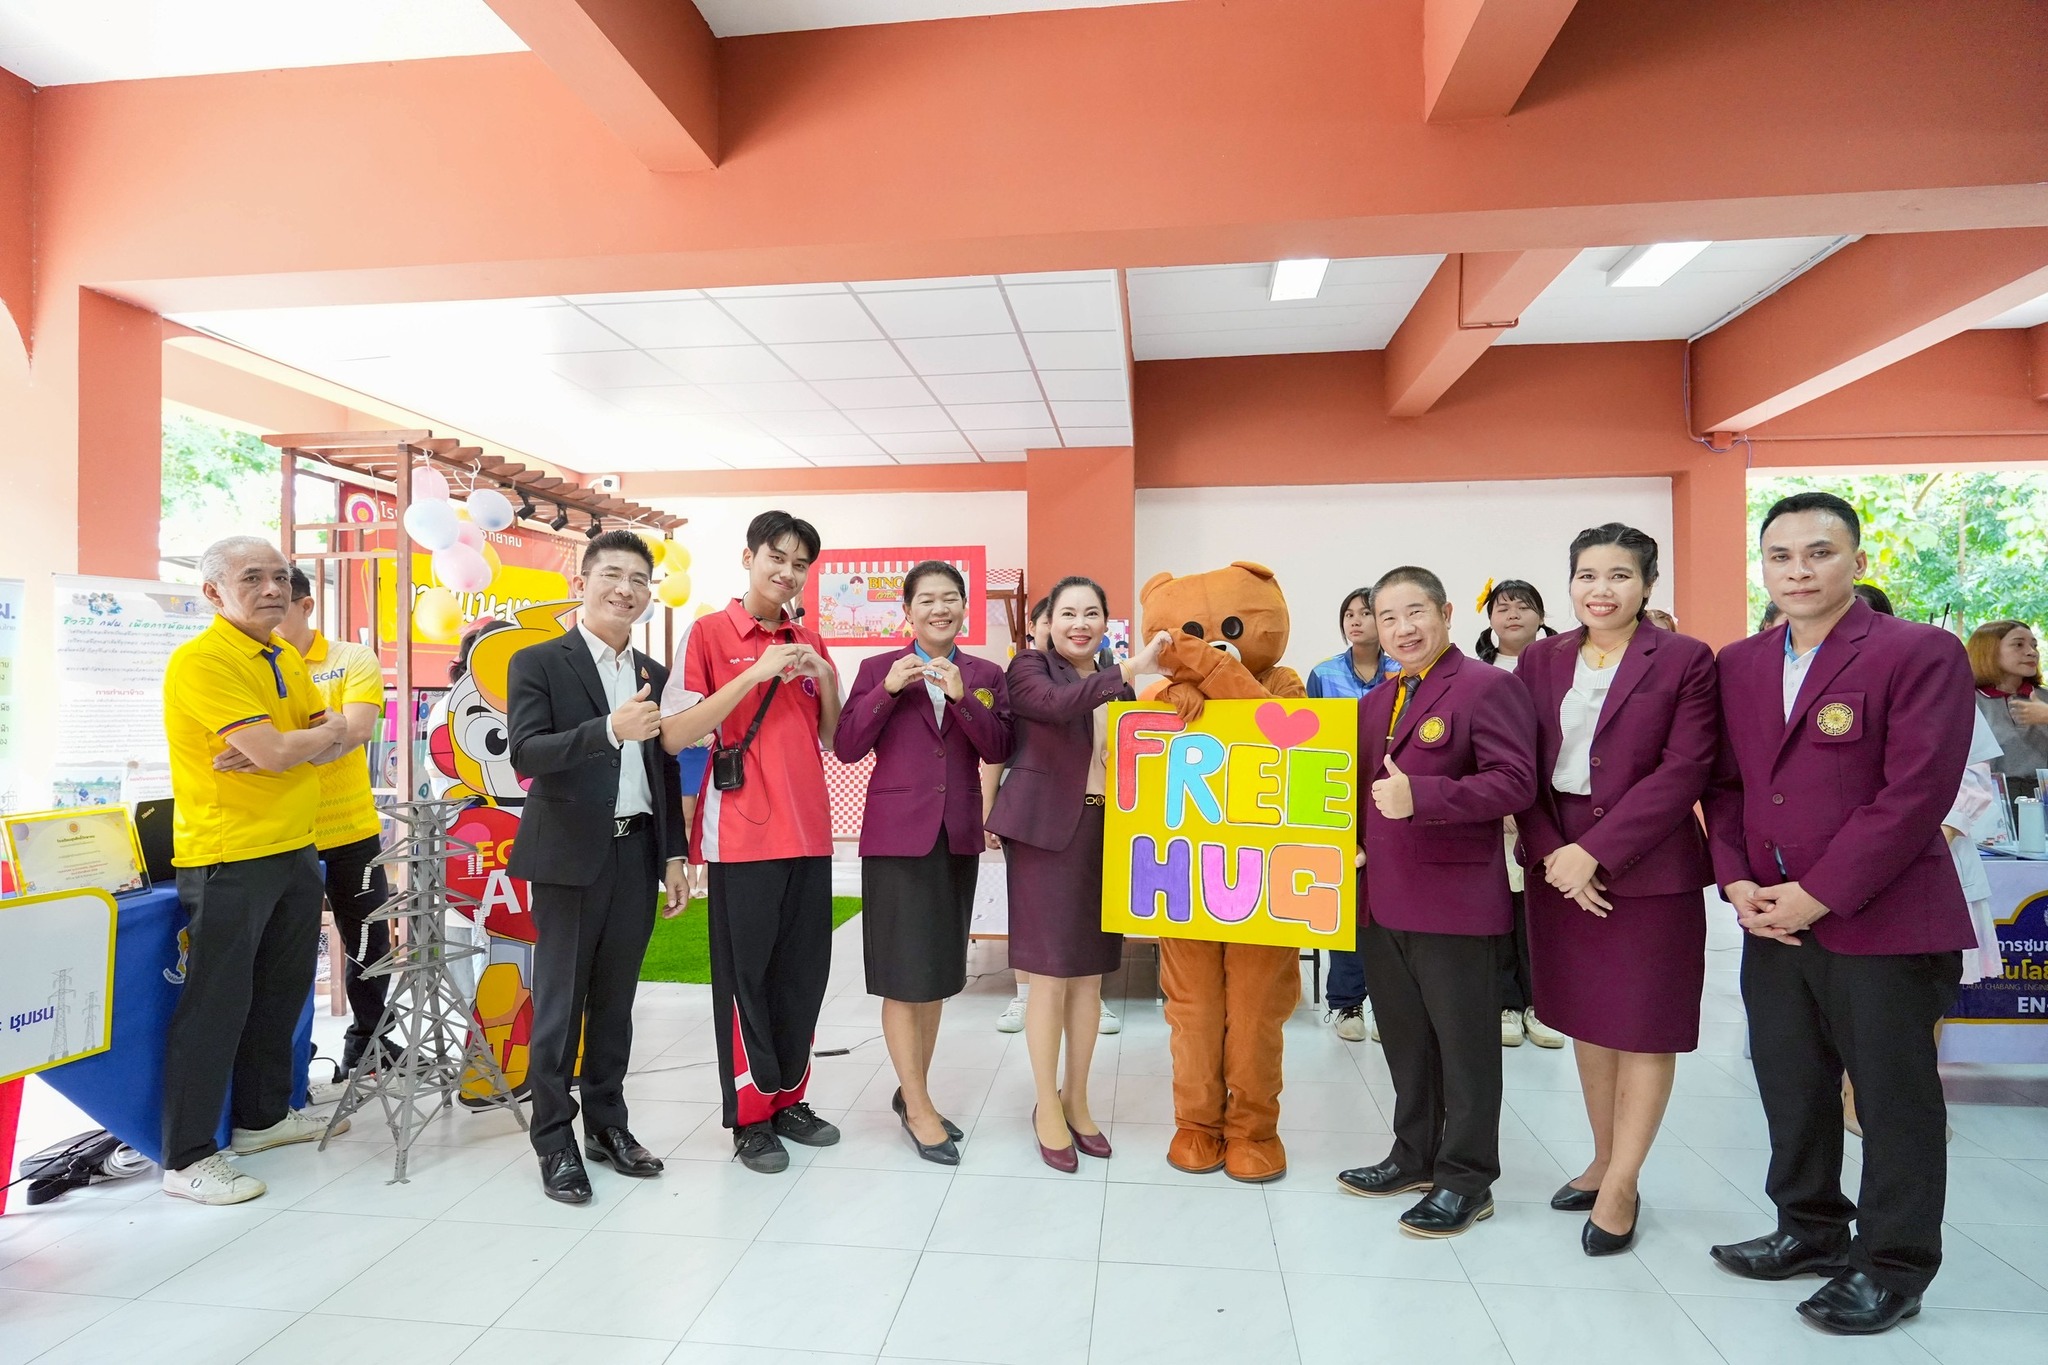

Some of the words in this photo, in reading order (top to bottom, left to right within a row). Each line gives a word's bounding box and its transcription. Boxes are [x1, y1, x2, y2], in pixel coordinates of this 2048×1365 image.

[129, 618, 208, 631] เพื่อการพัฒนาอ
[312, 668, 345, 683] EGAT
[1117, 711, 1352, 829] FREE
[1130, 835, 1342, 933] HUG
[1985, 982, 2021, 991] CHABANG
[10, 1006, 55, 1032] ชุมชน
